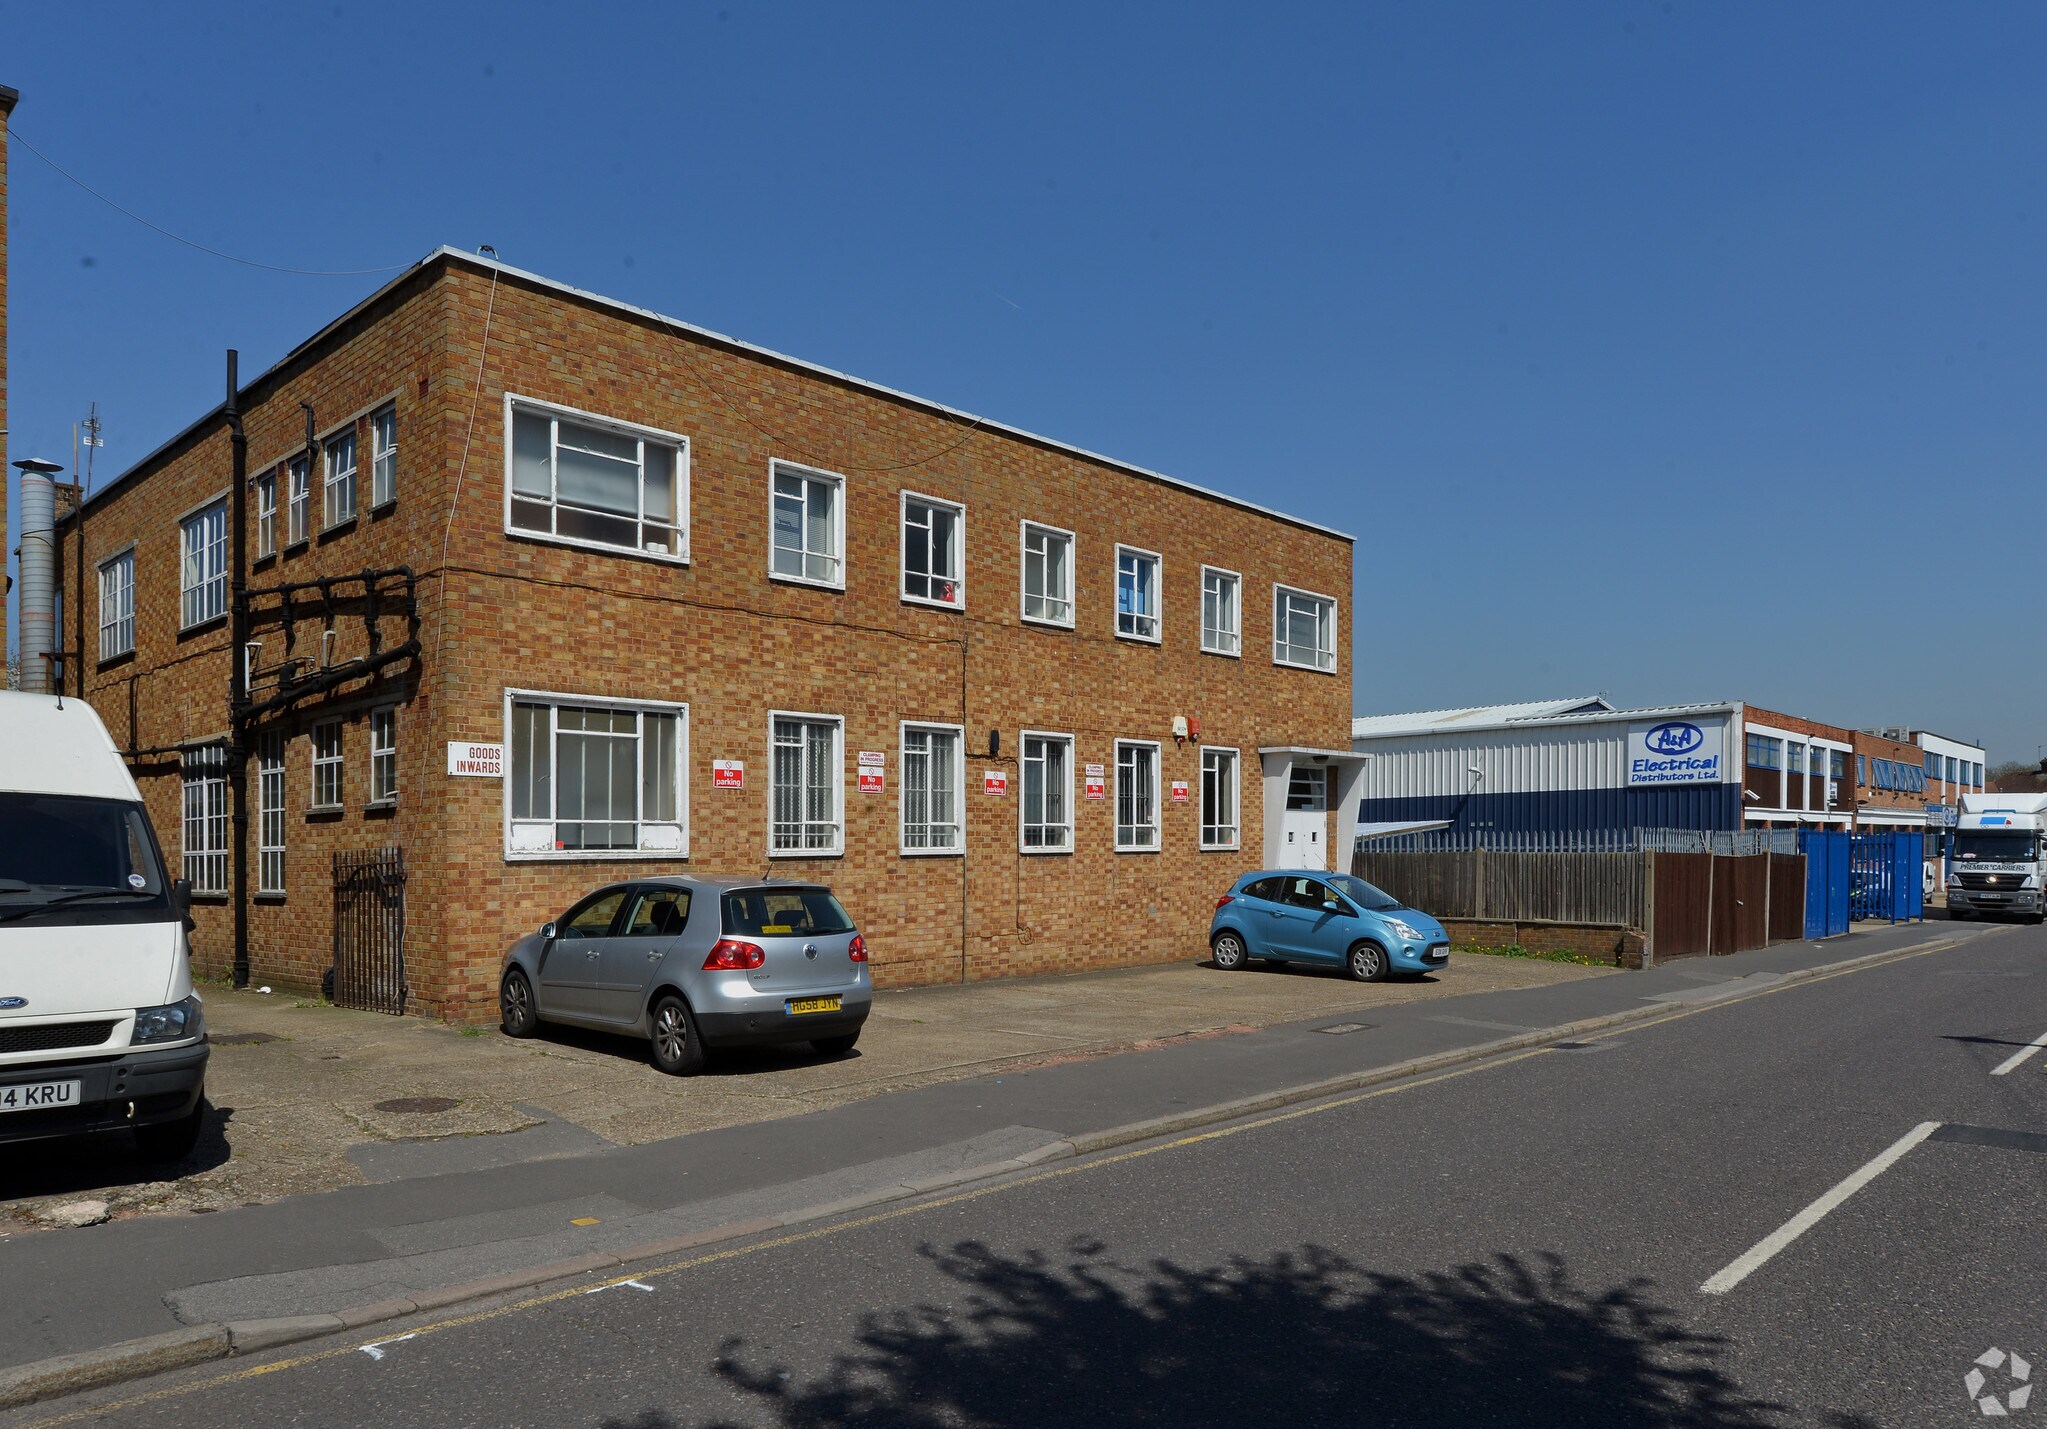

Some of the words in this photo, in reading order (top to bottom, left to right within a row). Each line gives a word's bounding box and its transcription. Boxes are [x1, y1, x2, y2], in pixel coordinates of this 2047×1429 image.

[1658, 727, 1691, 750] A&A
[469, 747, 500, 759] GOODS
[456, 760, 500, 773] INWARDS
[1632, 755, 1718, 772] Electrical
[723, 769, 734, 777] No
[1632, 772, 1694, 782] Distributors
[1697, 770, 1719, 780] Ltd.
[716, 778, 741, 787] parking
[1960, 863, 1989, 871] PREMIER
[1992, 864, 2026, 872] CARRIERS
[0, 998, 21, 1007] Ford
[792, 999, 818, 1012] HG58
[821, 998, 839, 1010] JYN
[0, 1087, 18, 1108] 4
[25, 1084, 70, 1106] KRU
